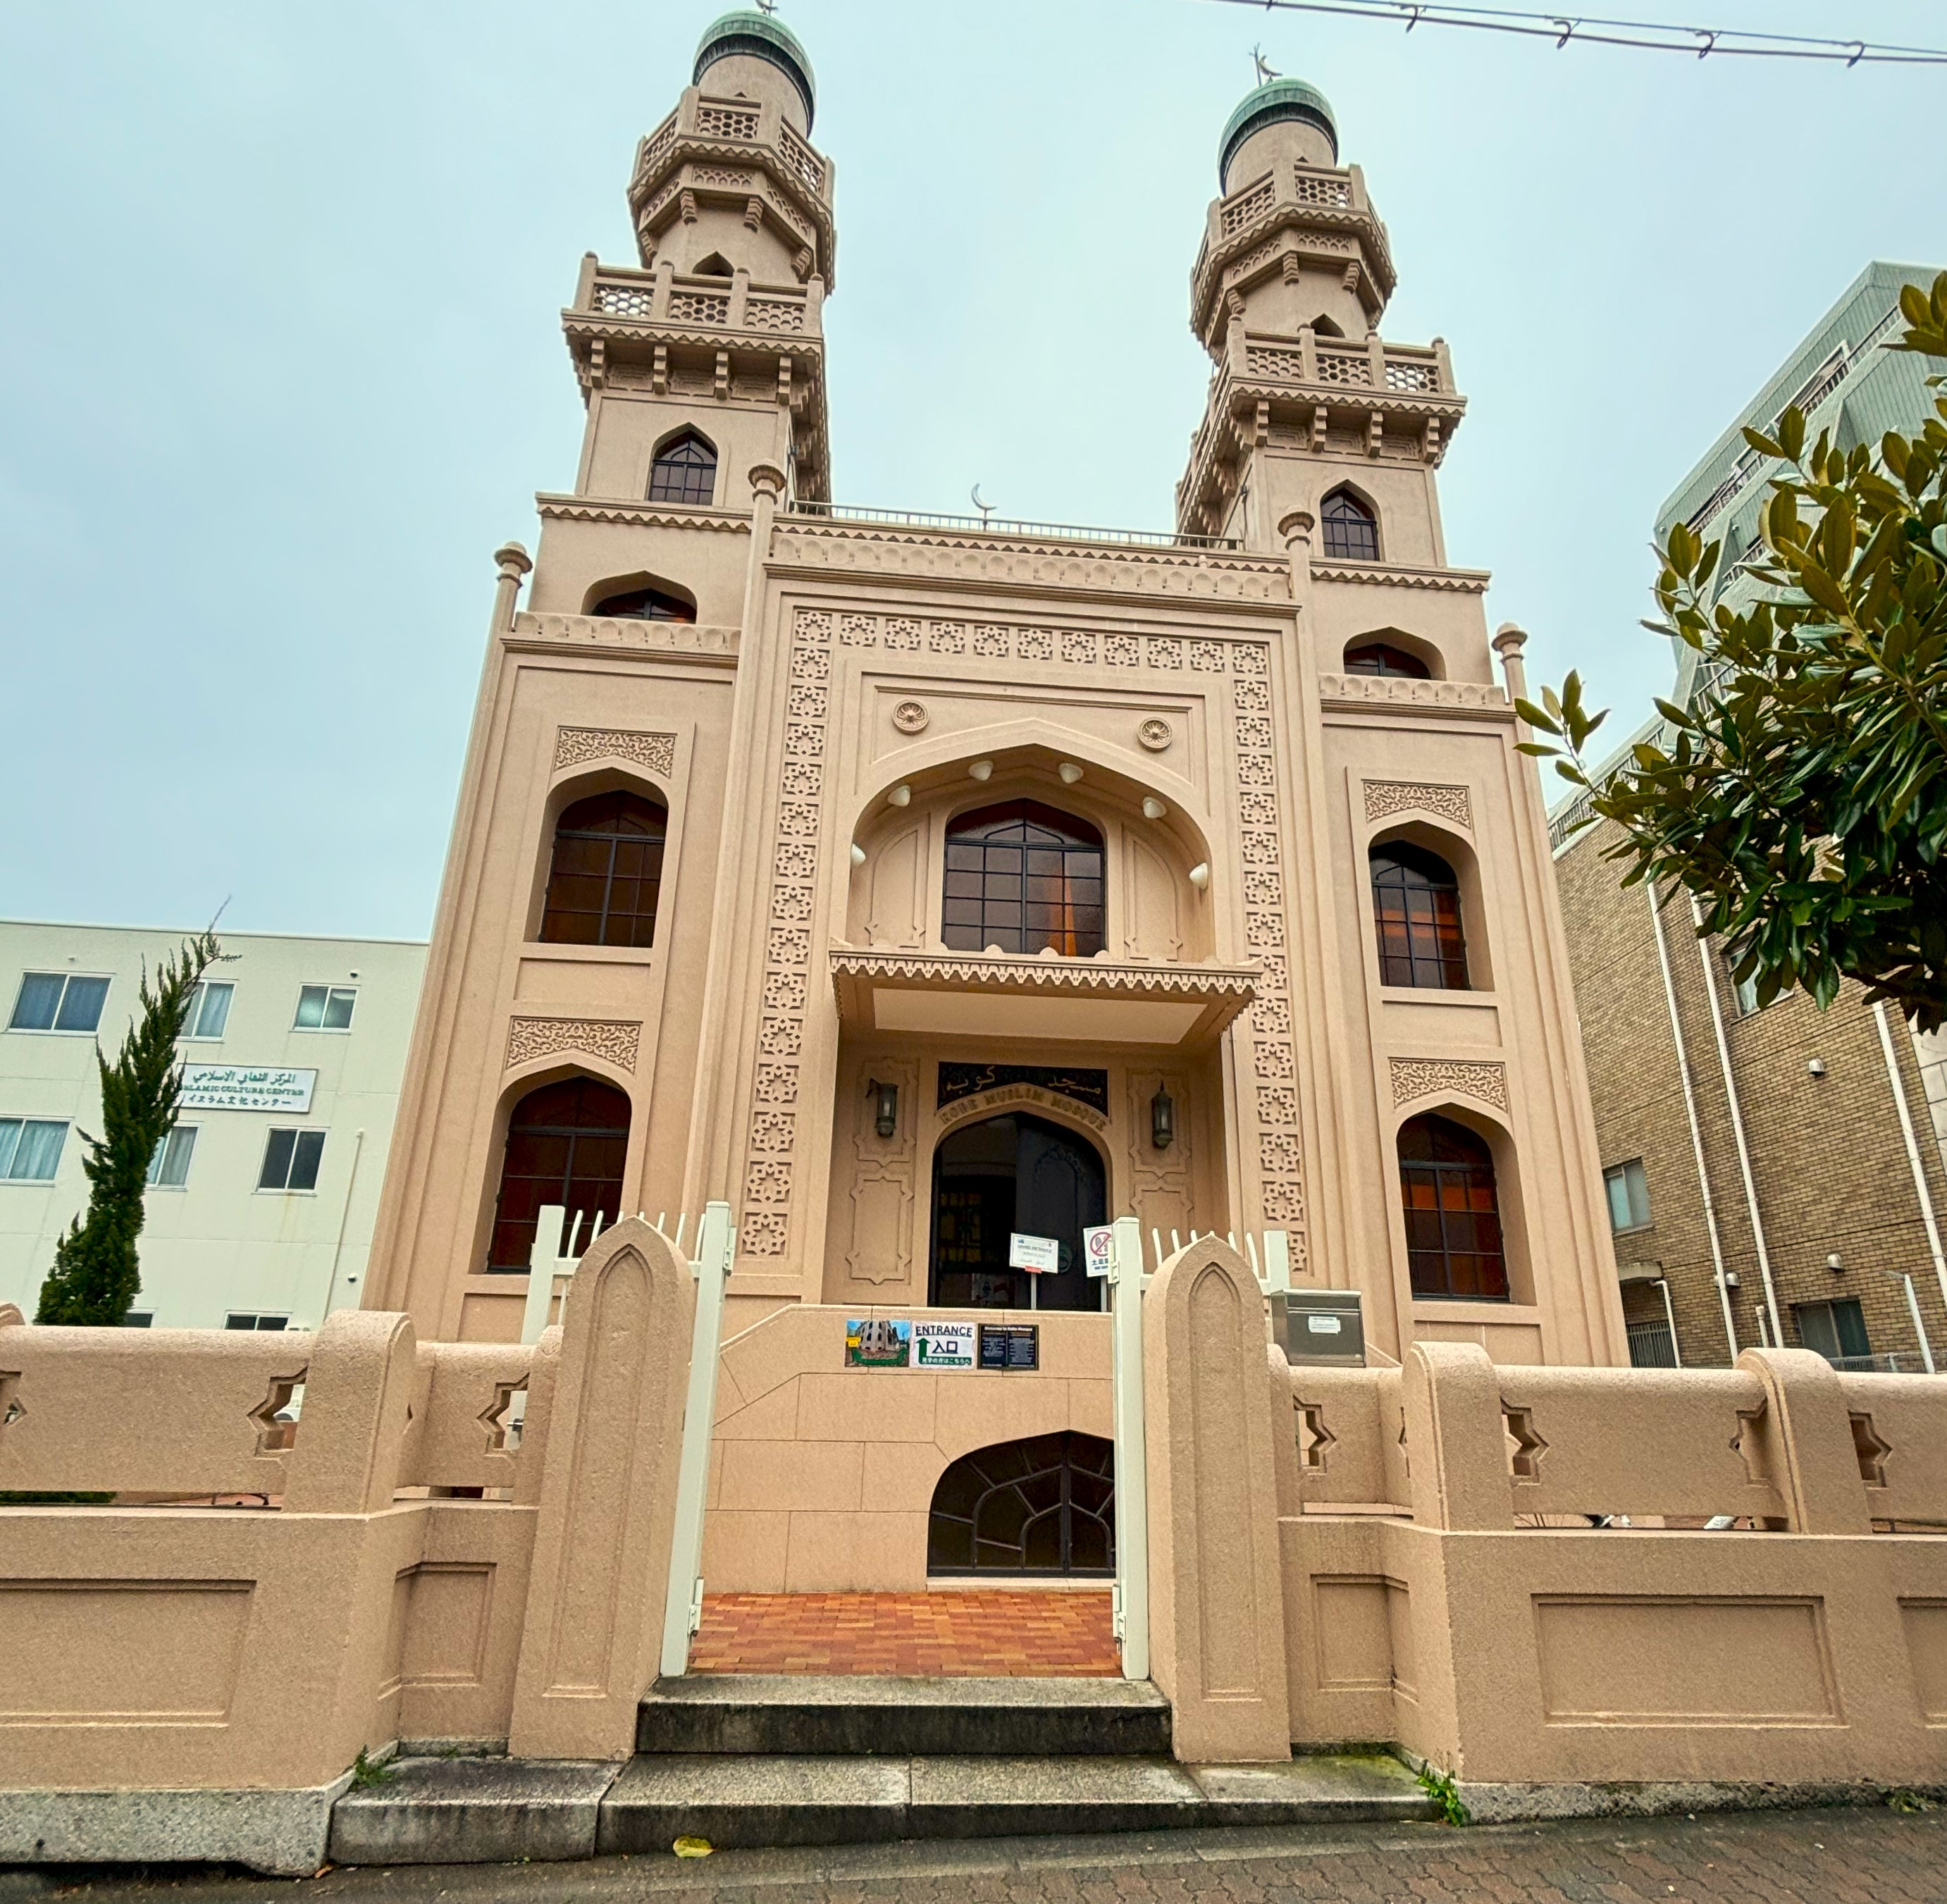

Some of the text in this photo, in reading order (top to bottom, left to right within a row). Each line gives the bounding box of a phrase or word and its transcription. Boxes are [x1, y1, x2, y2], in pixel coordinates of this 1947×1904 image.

[270, 1072, 296, 1086] المركز
[1048, 1075, 1101, 1095] مسجد
[221, 1086, 264, 1094] CULTURE
[939, 1087, 1106, 1131] KOBE MUSLIM MOSQUE
[915, 1325, 972, 1337] ENTRANCE
[932, 1339, 958, 1354] 入口
